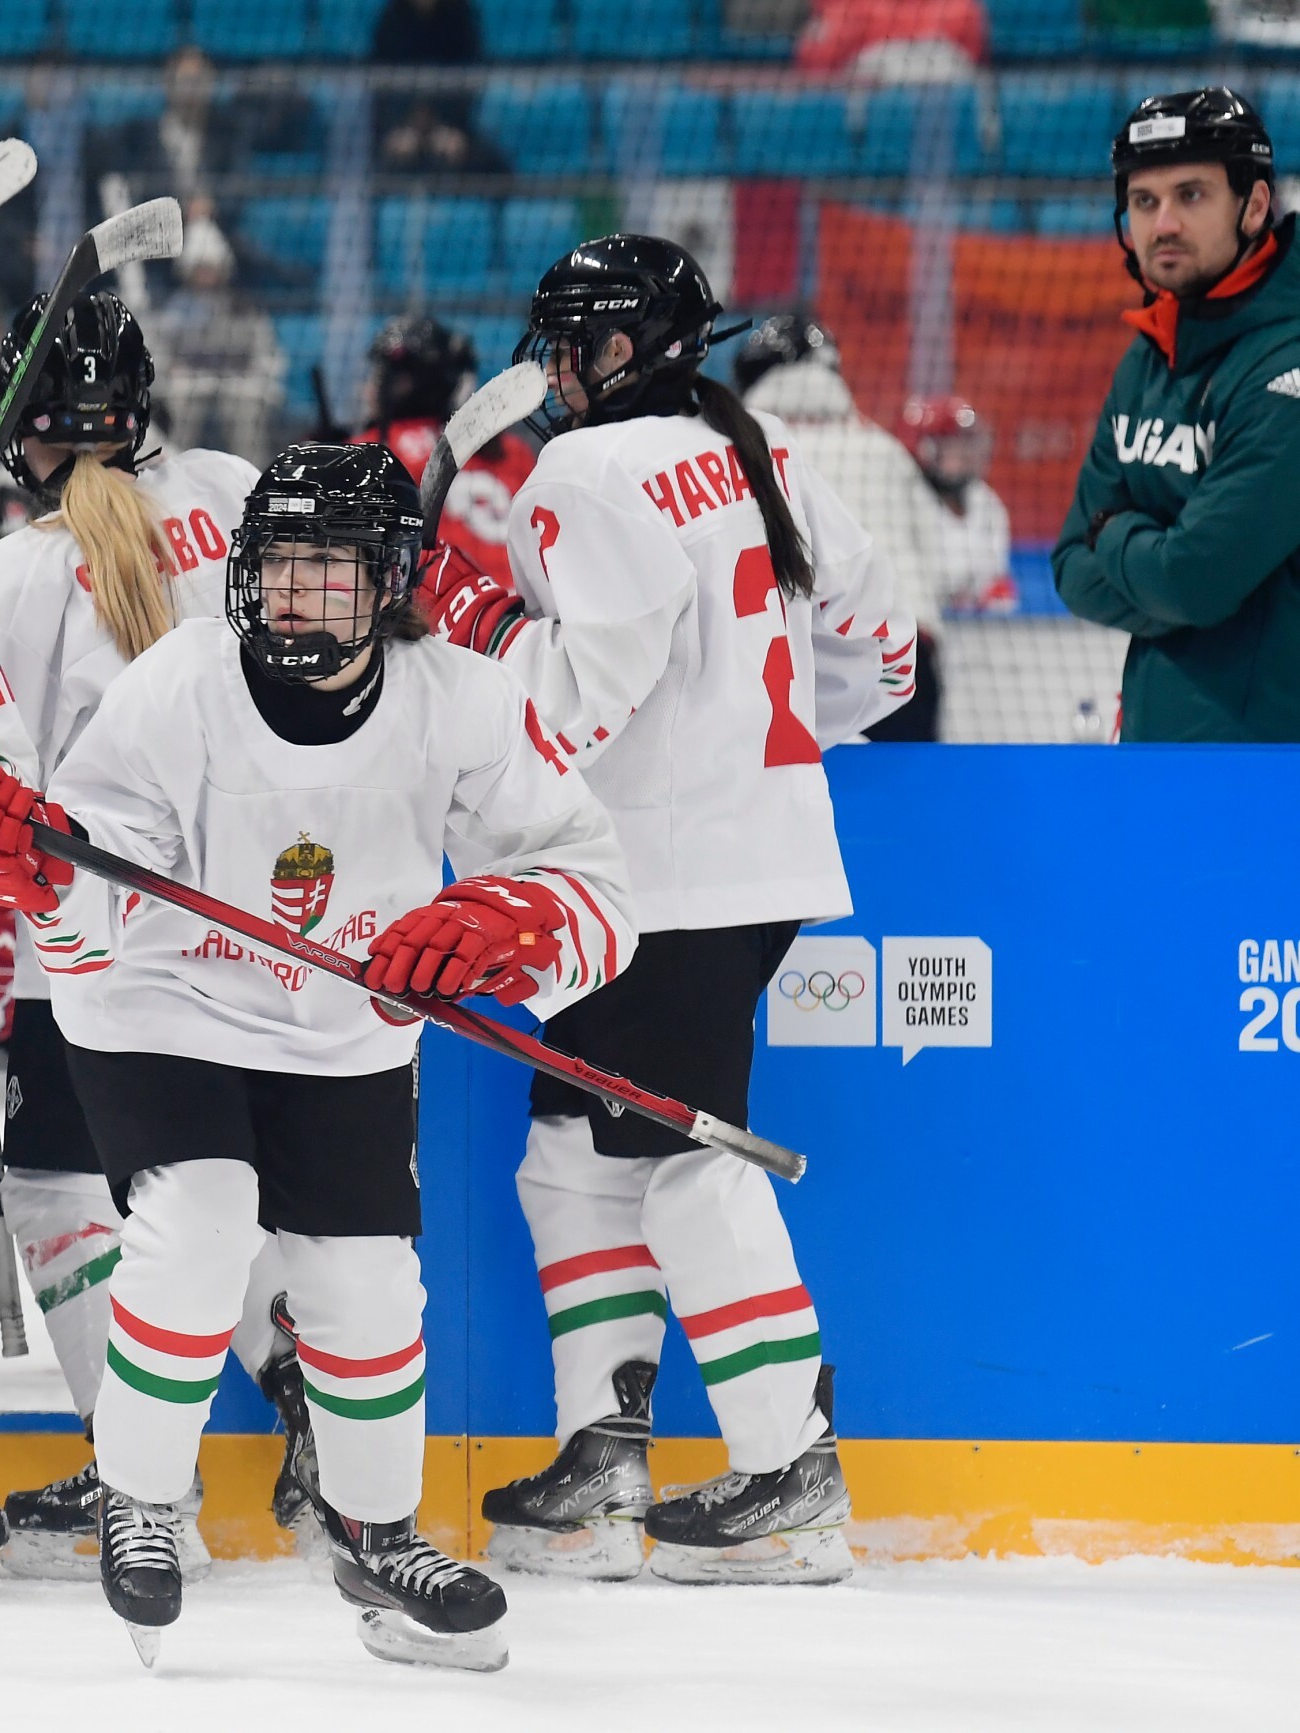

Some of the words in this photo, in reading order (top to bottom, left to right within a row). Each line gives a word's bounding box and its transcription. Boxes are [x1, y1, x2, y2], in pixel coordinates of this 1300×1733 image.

[593, 299, 639, 312] CCM
[84, 356, 97, 383] 3
[603, 370, 626, 391] CCM
[292, 464, 306, 480] 4
[400, 516, 424, 527] CCM
[267, 653, 321, 666] CCM
[733, 544, 822, 768] 2
[286, 933, 356, 978] VAPOR
[908, 957, 966, 977] YOUTH
[898, 982, 977, 1002] OLYMPIC
[906, 1006, 969, 1027] GAMES
[584, 1071, 642, 1100] BAUER
